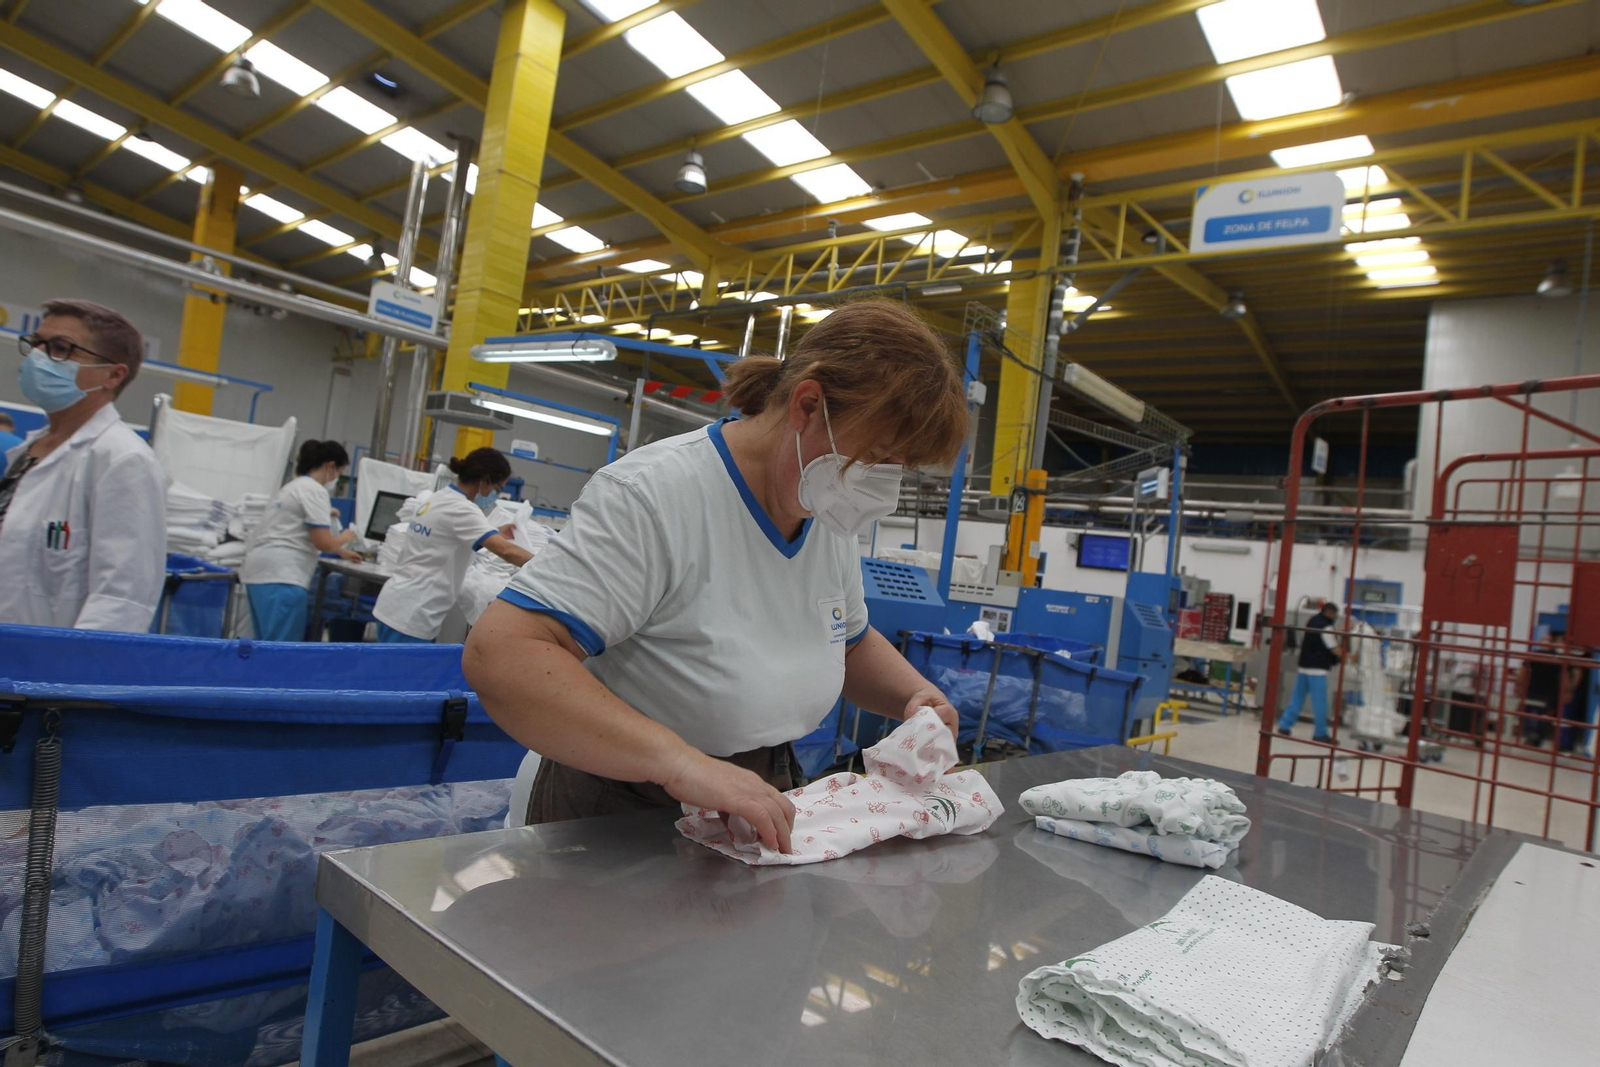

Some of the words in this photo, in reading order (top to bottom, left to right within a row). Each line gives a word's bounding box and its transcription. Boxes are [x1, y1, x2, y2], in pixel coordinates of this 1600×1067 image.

[1223, 223, 1255, 235] ZONA
[1257, 220, 1272, 231] DE
[1276, 217, 1310, 229] FELPA
